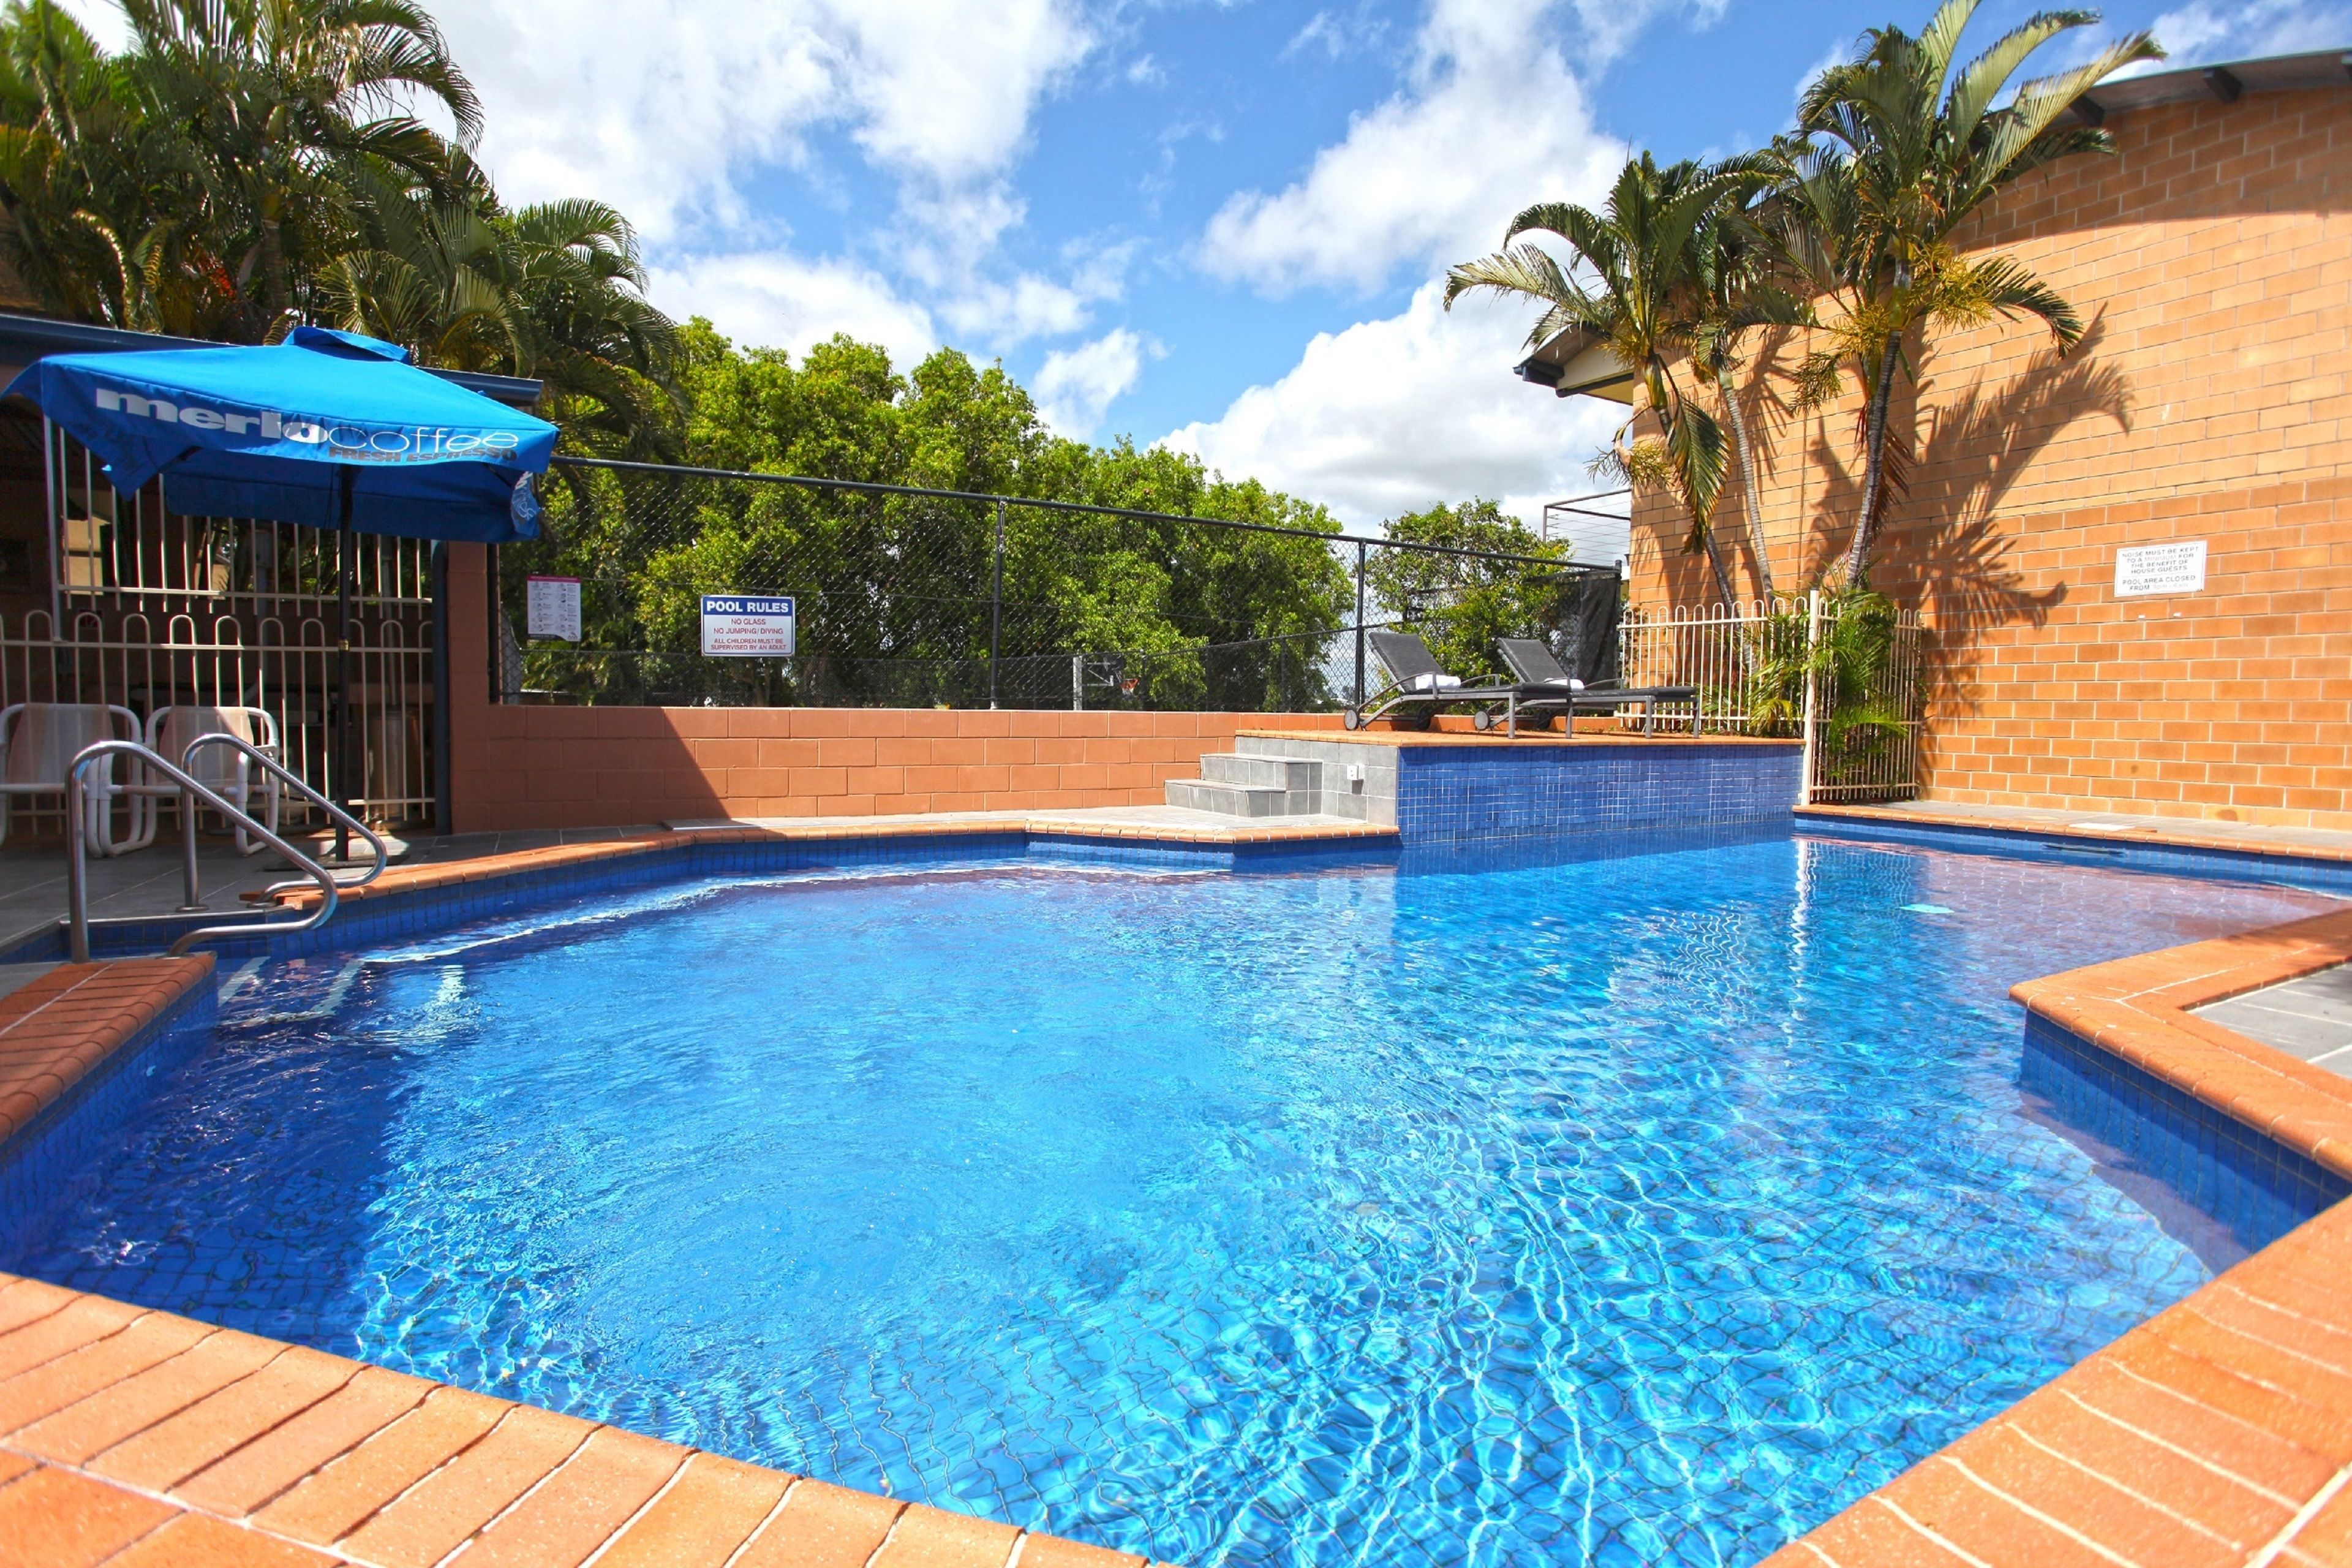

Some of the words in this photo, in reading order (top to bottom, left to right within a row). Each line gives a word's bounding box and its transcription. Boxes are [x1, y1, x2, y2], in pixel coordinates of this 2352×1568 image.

[97, 388, 328, 444] merlo
[329, 427, 519, 453] coffee
[329, 447, 402, 462] FRESH
[406, 448, 518, 462] ESPRESSO
[706, 601, 743, 612] POOL
[747, 602, 789, 612] RULES
